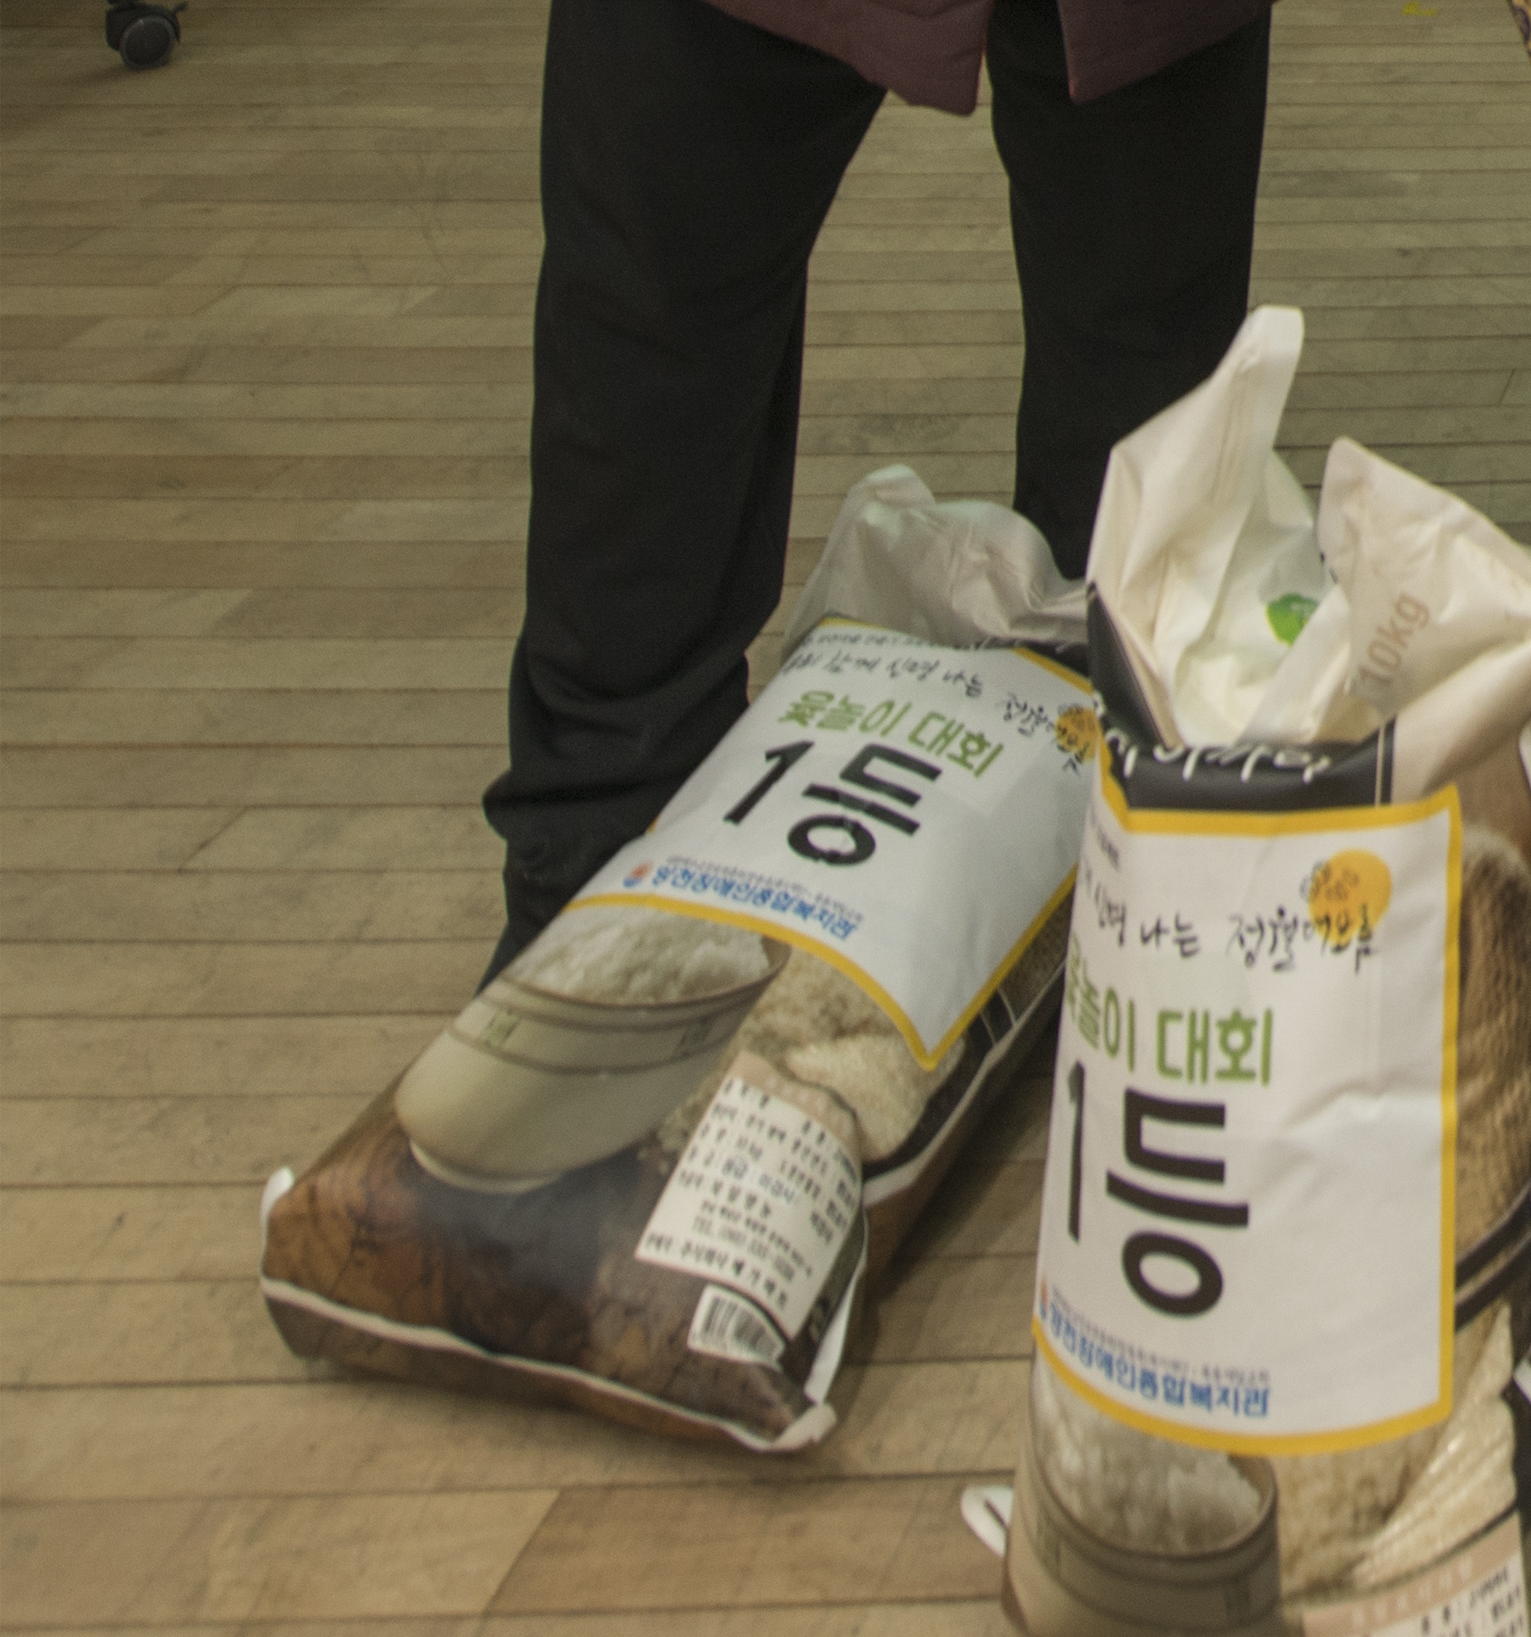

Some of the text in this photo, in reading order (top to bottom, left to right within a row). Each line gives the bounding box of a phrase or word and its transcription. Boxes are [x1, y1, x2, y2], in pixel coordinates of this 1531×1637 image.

[1356, 590, 1432, 688] 10kg
[777, 689, 1005, 779] 윷놀이 대회
[721, 740, 945, 869] 1등
[1139, 911, 1201, 960] 나는
[1156, 1007, 1273, 1085] 대회
[1066, 1060, 1250, 1319] 1등
